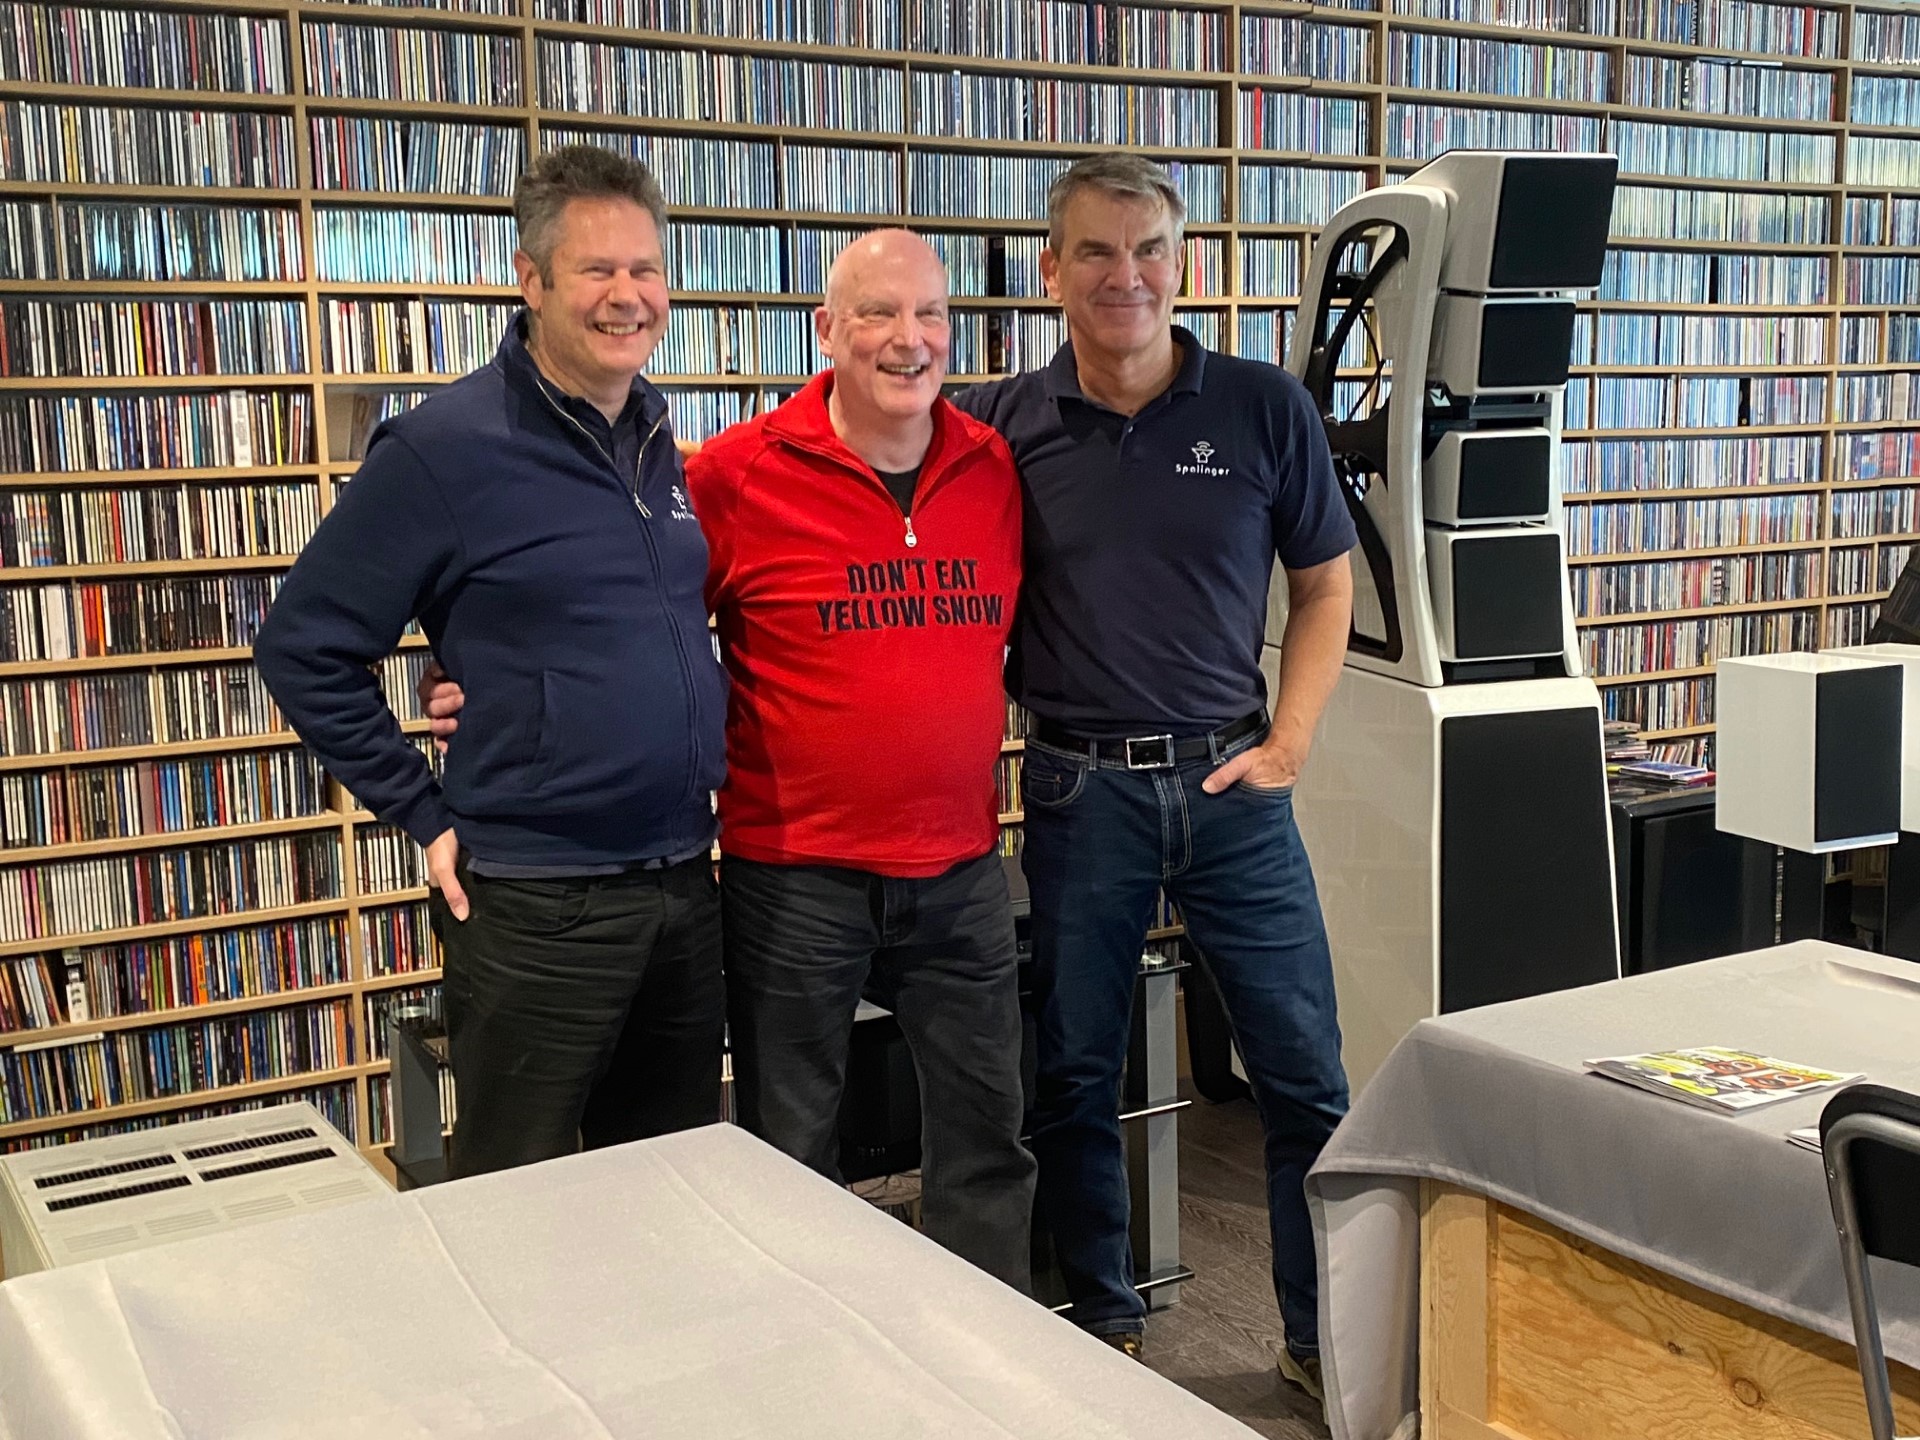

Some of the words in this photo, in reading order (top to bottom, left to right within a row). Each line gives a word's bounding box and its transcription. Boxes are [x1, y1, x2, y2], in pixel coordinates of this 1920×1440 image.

[847, 559, 927, 594] DON'T
[935, 559, 978, 590] EAT
[816, 596, 926, 632] YELLOW
[932, 594, 1003, 626] SNOW
